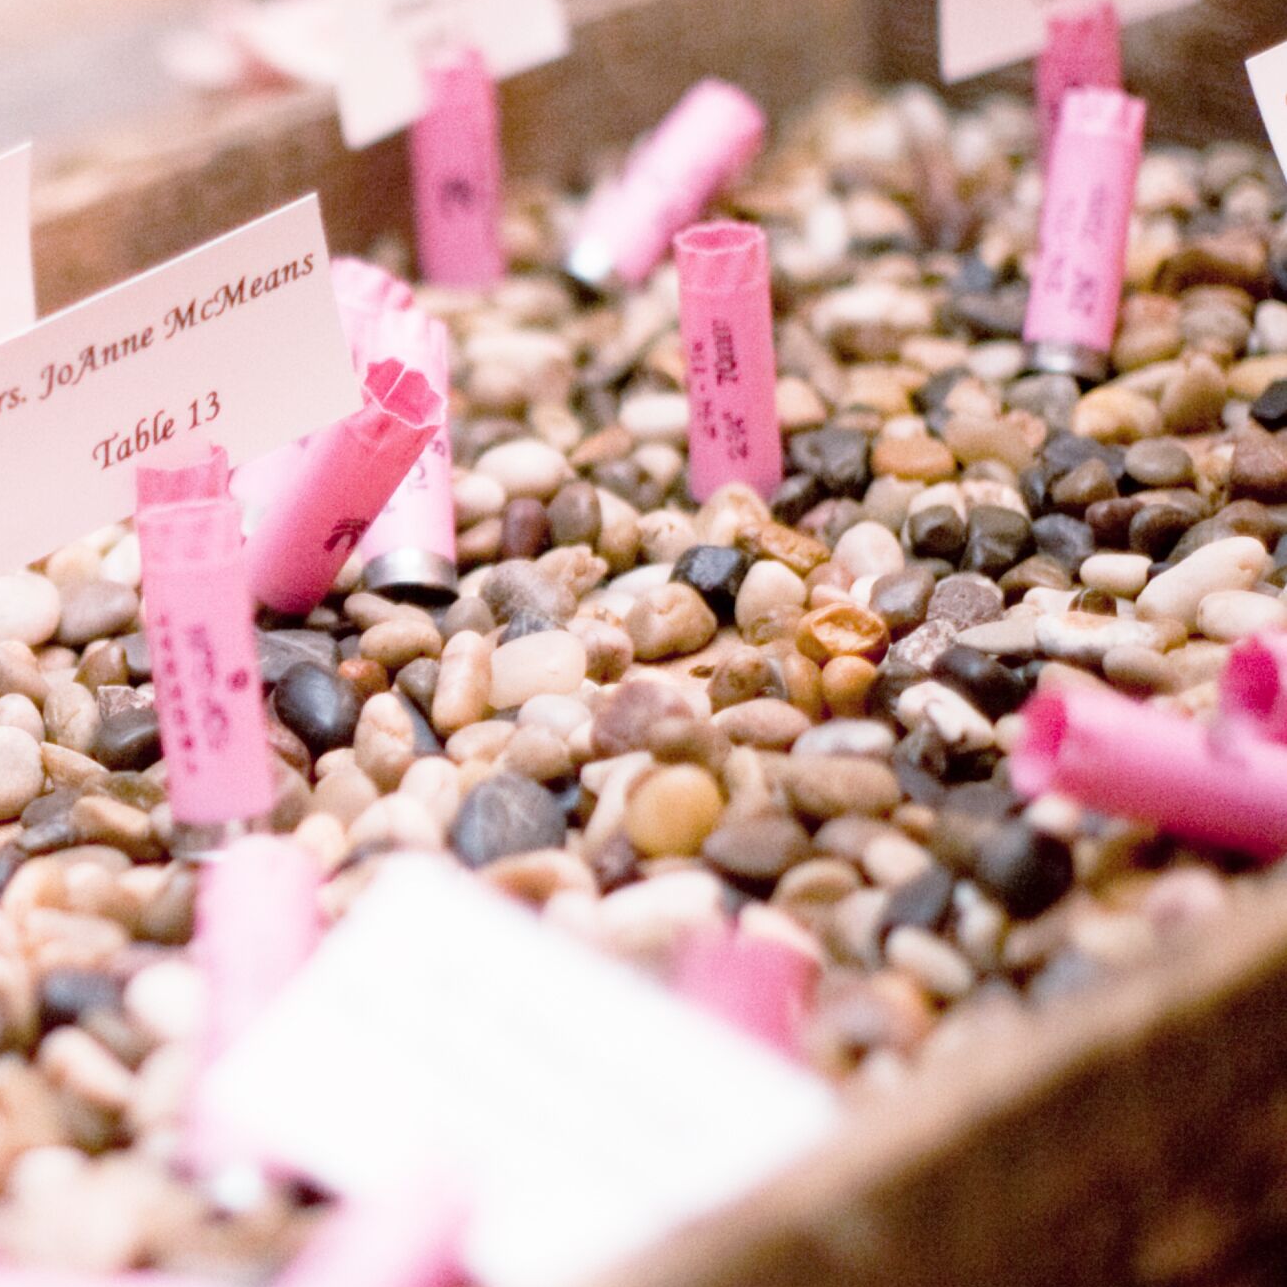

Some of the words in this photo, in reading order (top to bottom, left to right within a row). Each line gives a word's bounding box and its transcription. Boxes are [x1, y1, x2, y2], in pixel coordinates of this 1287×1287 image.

[38, 325, 155, 401] JoAnne
[163, 252, 315, 340] McMeans
[91, 409, 176, 471] Table
[187, 390, 221, 431] 13
